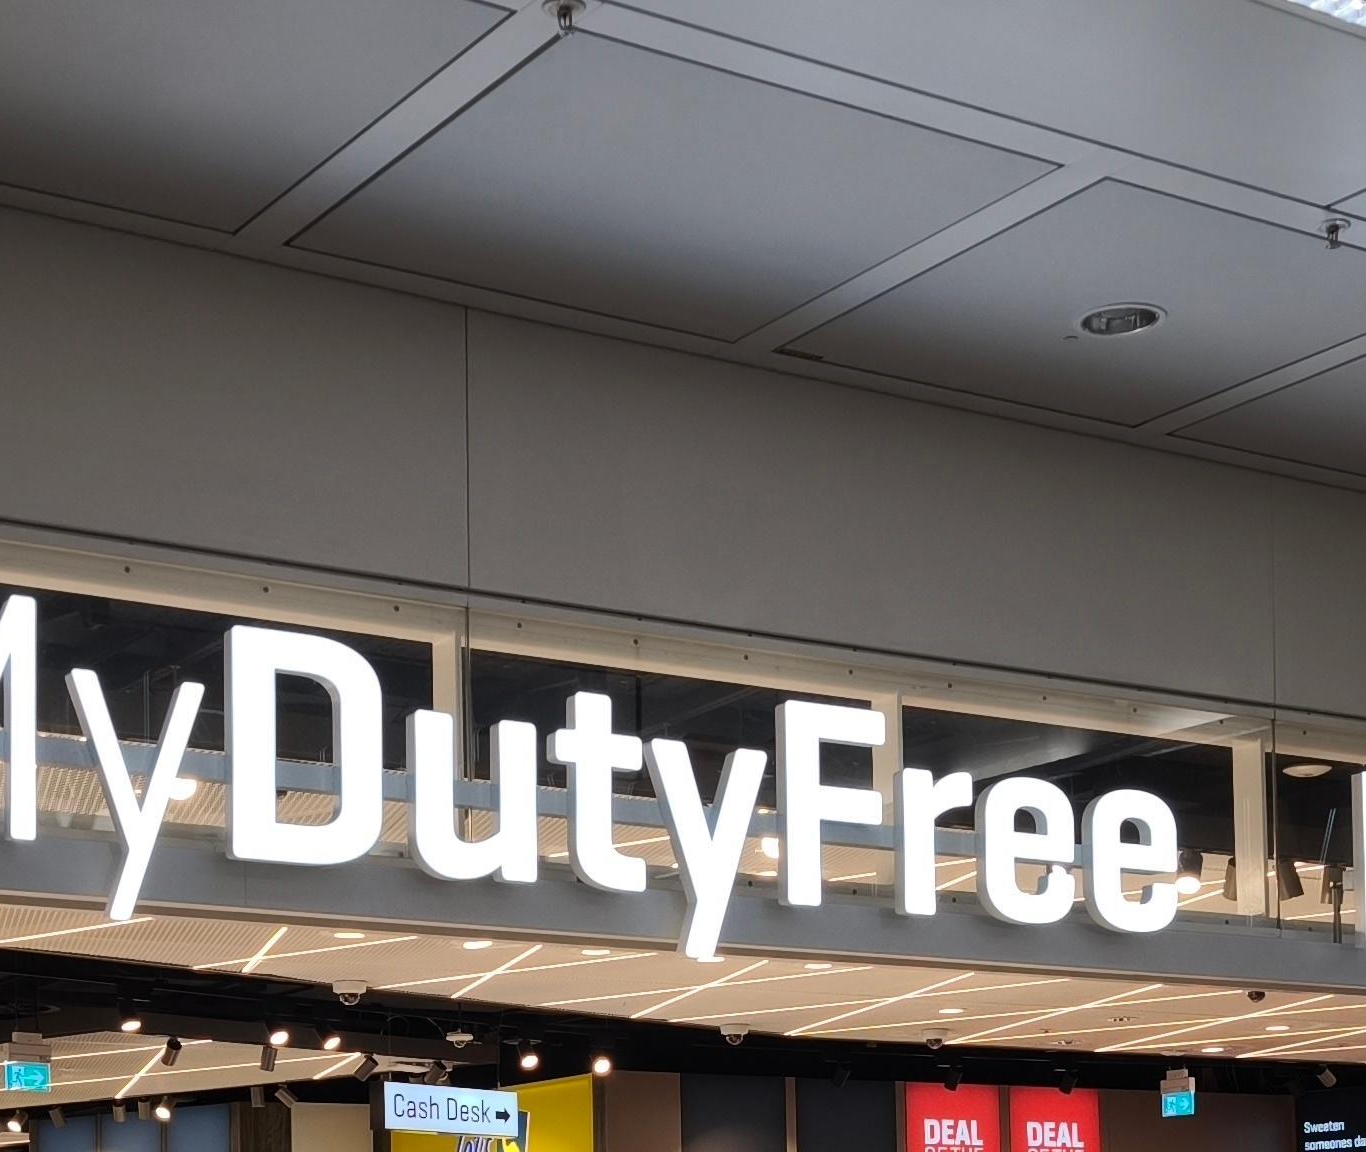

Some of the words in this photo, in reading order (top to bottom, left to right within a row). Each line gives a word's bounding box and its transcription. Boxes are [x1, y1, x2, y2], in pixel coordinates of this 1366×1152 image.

[393, 1093, 440, 1120] Cash
[446, 1097, 491, 1123] Desk
[923, 1118, 984, 1146] DEAL
[1026, 1121, 1085, 1148] DEAL
[1303, 1121, 1345, 1133] Sweeten
[1304, 1138, 1353, 1151] someones
